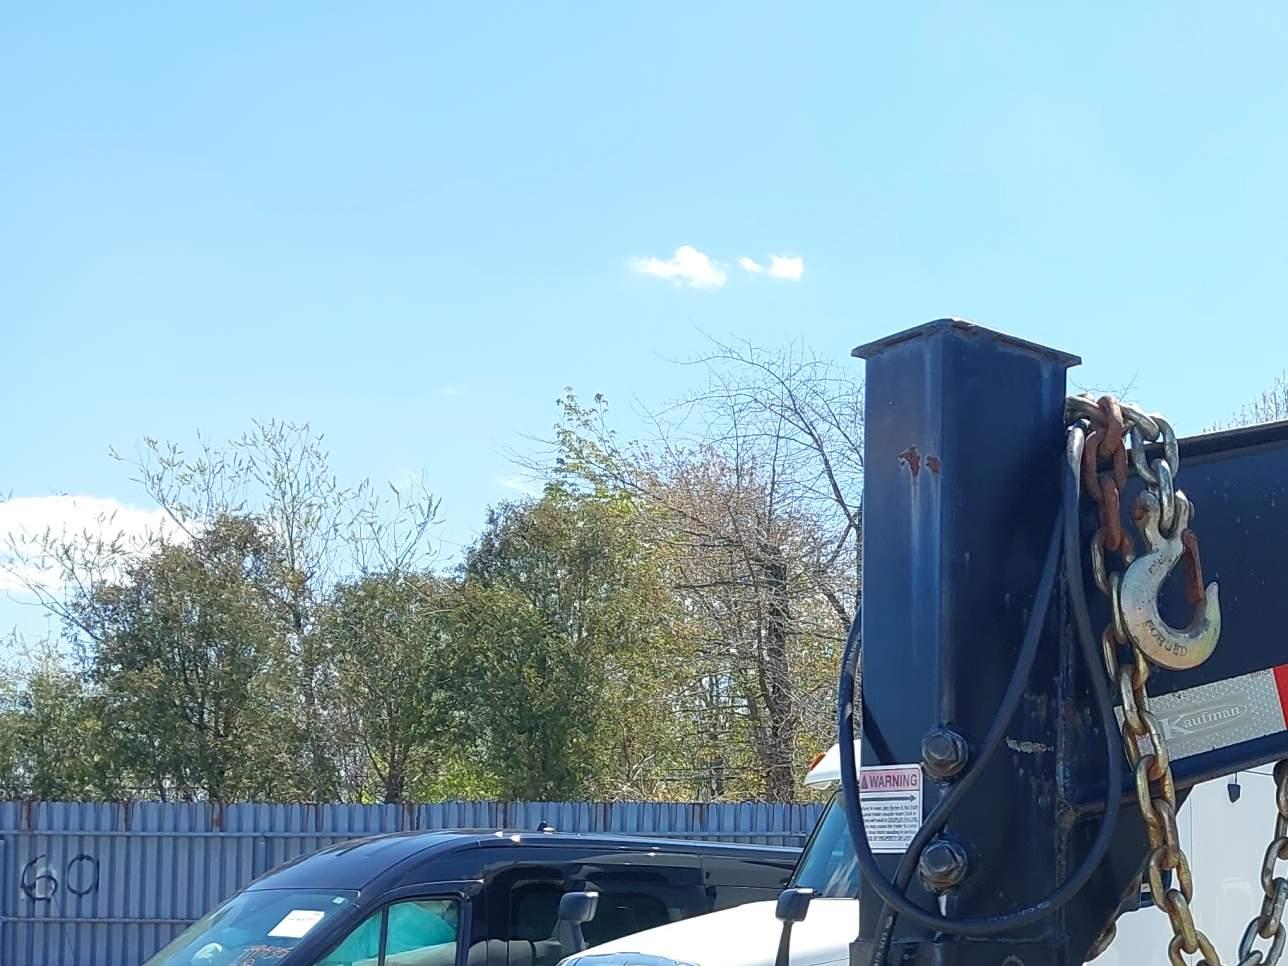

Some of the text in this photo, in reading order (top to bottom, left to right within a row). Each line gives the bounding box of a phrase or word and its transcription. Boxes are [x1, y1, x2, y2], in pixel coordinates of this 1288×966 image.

[1144, 619, 1188, 656] FORGED
[1158, 705, 1241, 741] Kaufman
[869, 774, 918, 788] WARNING
[20, 853, 100, 904] 60
